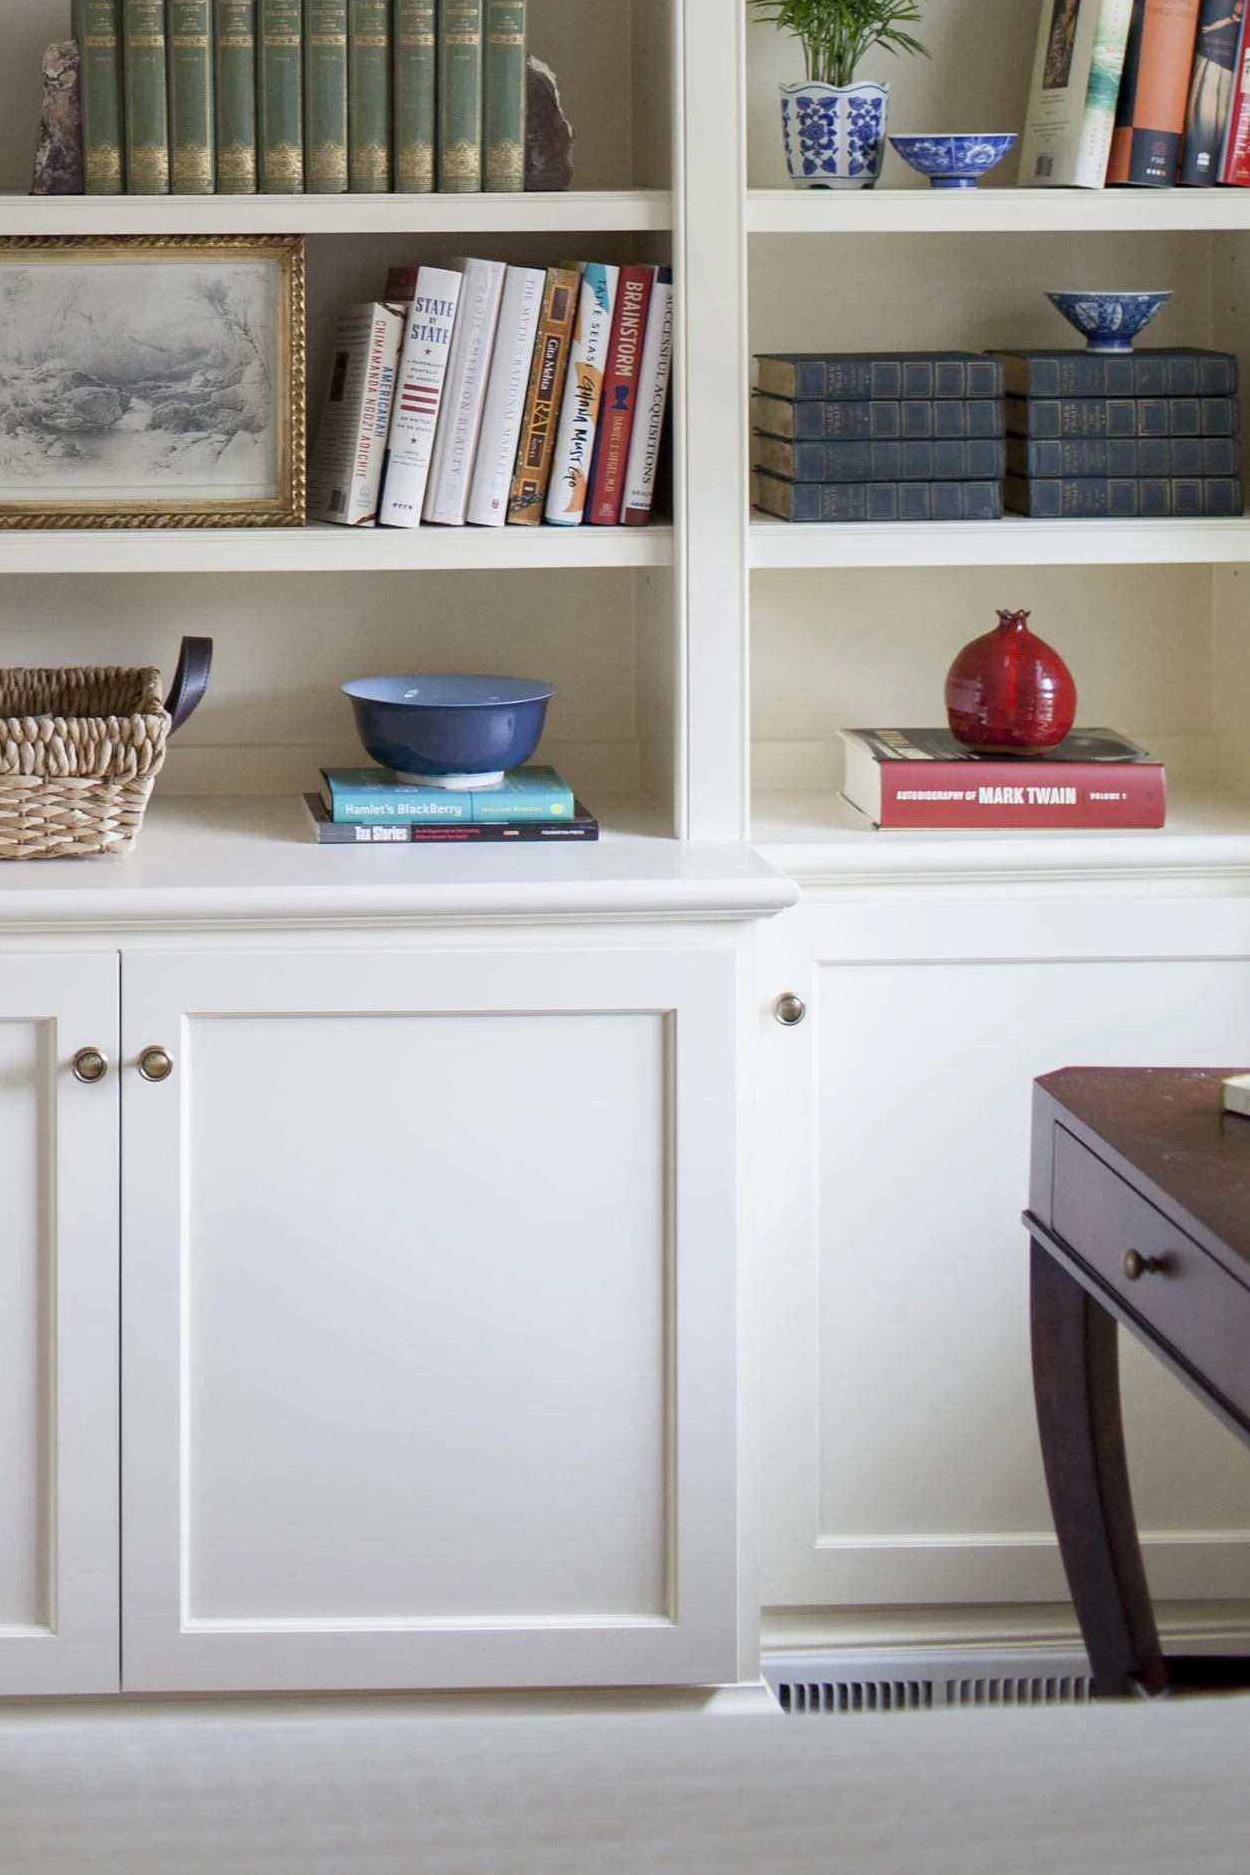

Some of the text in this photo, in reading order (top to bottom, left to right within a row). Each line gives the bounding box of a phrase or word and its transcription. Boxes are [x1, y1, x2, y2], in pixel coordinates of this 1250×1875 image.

[415, 297, 454, 317] STATE
[524, 279, 535, 300] THE
[411, 324, 450, 345] STATE
[518, 307, 531, 342] MYTH
[586, 279, 607, 368] TAIYE SELASI
[614, 281, 644, 377] BRAINSTORM
[656, 292, 673, 380] SUCCESSFUL
[464, 338, 481, 385] SMITH
[540, 339, 559, 391] Gita Mehta
[355, 320, 386, 479] CHIMAMANDA NGOZI ADICHIE
[374, 366, 393, 438] AMERICANAH
[460, 391, 471, 411] ON
[505, 359, 524, 421] RATIONAL
[572, 375, 596, 423] GHANA
[450, 417, 469, 476] BEAUTY
[611, 415, 624, 441] DANIEL
[642, 384, 665, 484] ACQUISITIONS
[496, 429, 511, 476] MARKET
[346, 803, 462, 817] Hamlet's BlackBerry
[896, 787, 1077, 805] AUTOBIOGRAPHY OF MARK TWAIN
[1090, 793, 1120, 801] VOLUME
[355, 826, 372, 841] Tax
[372, 825, 407, 841] Stories
